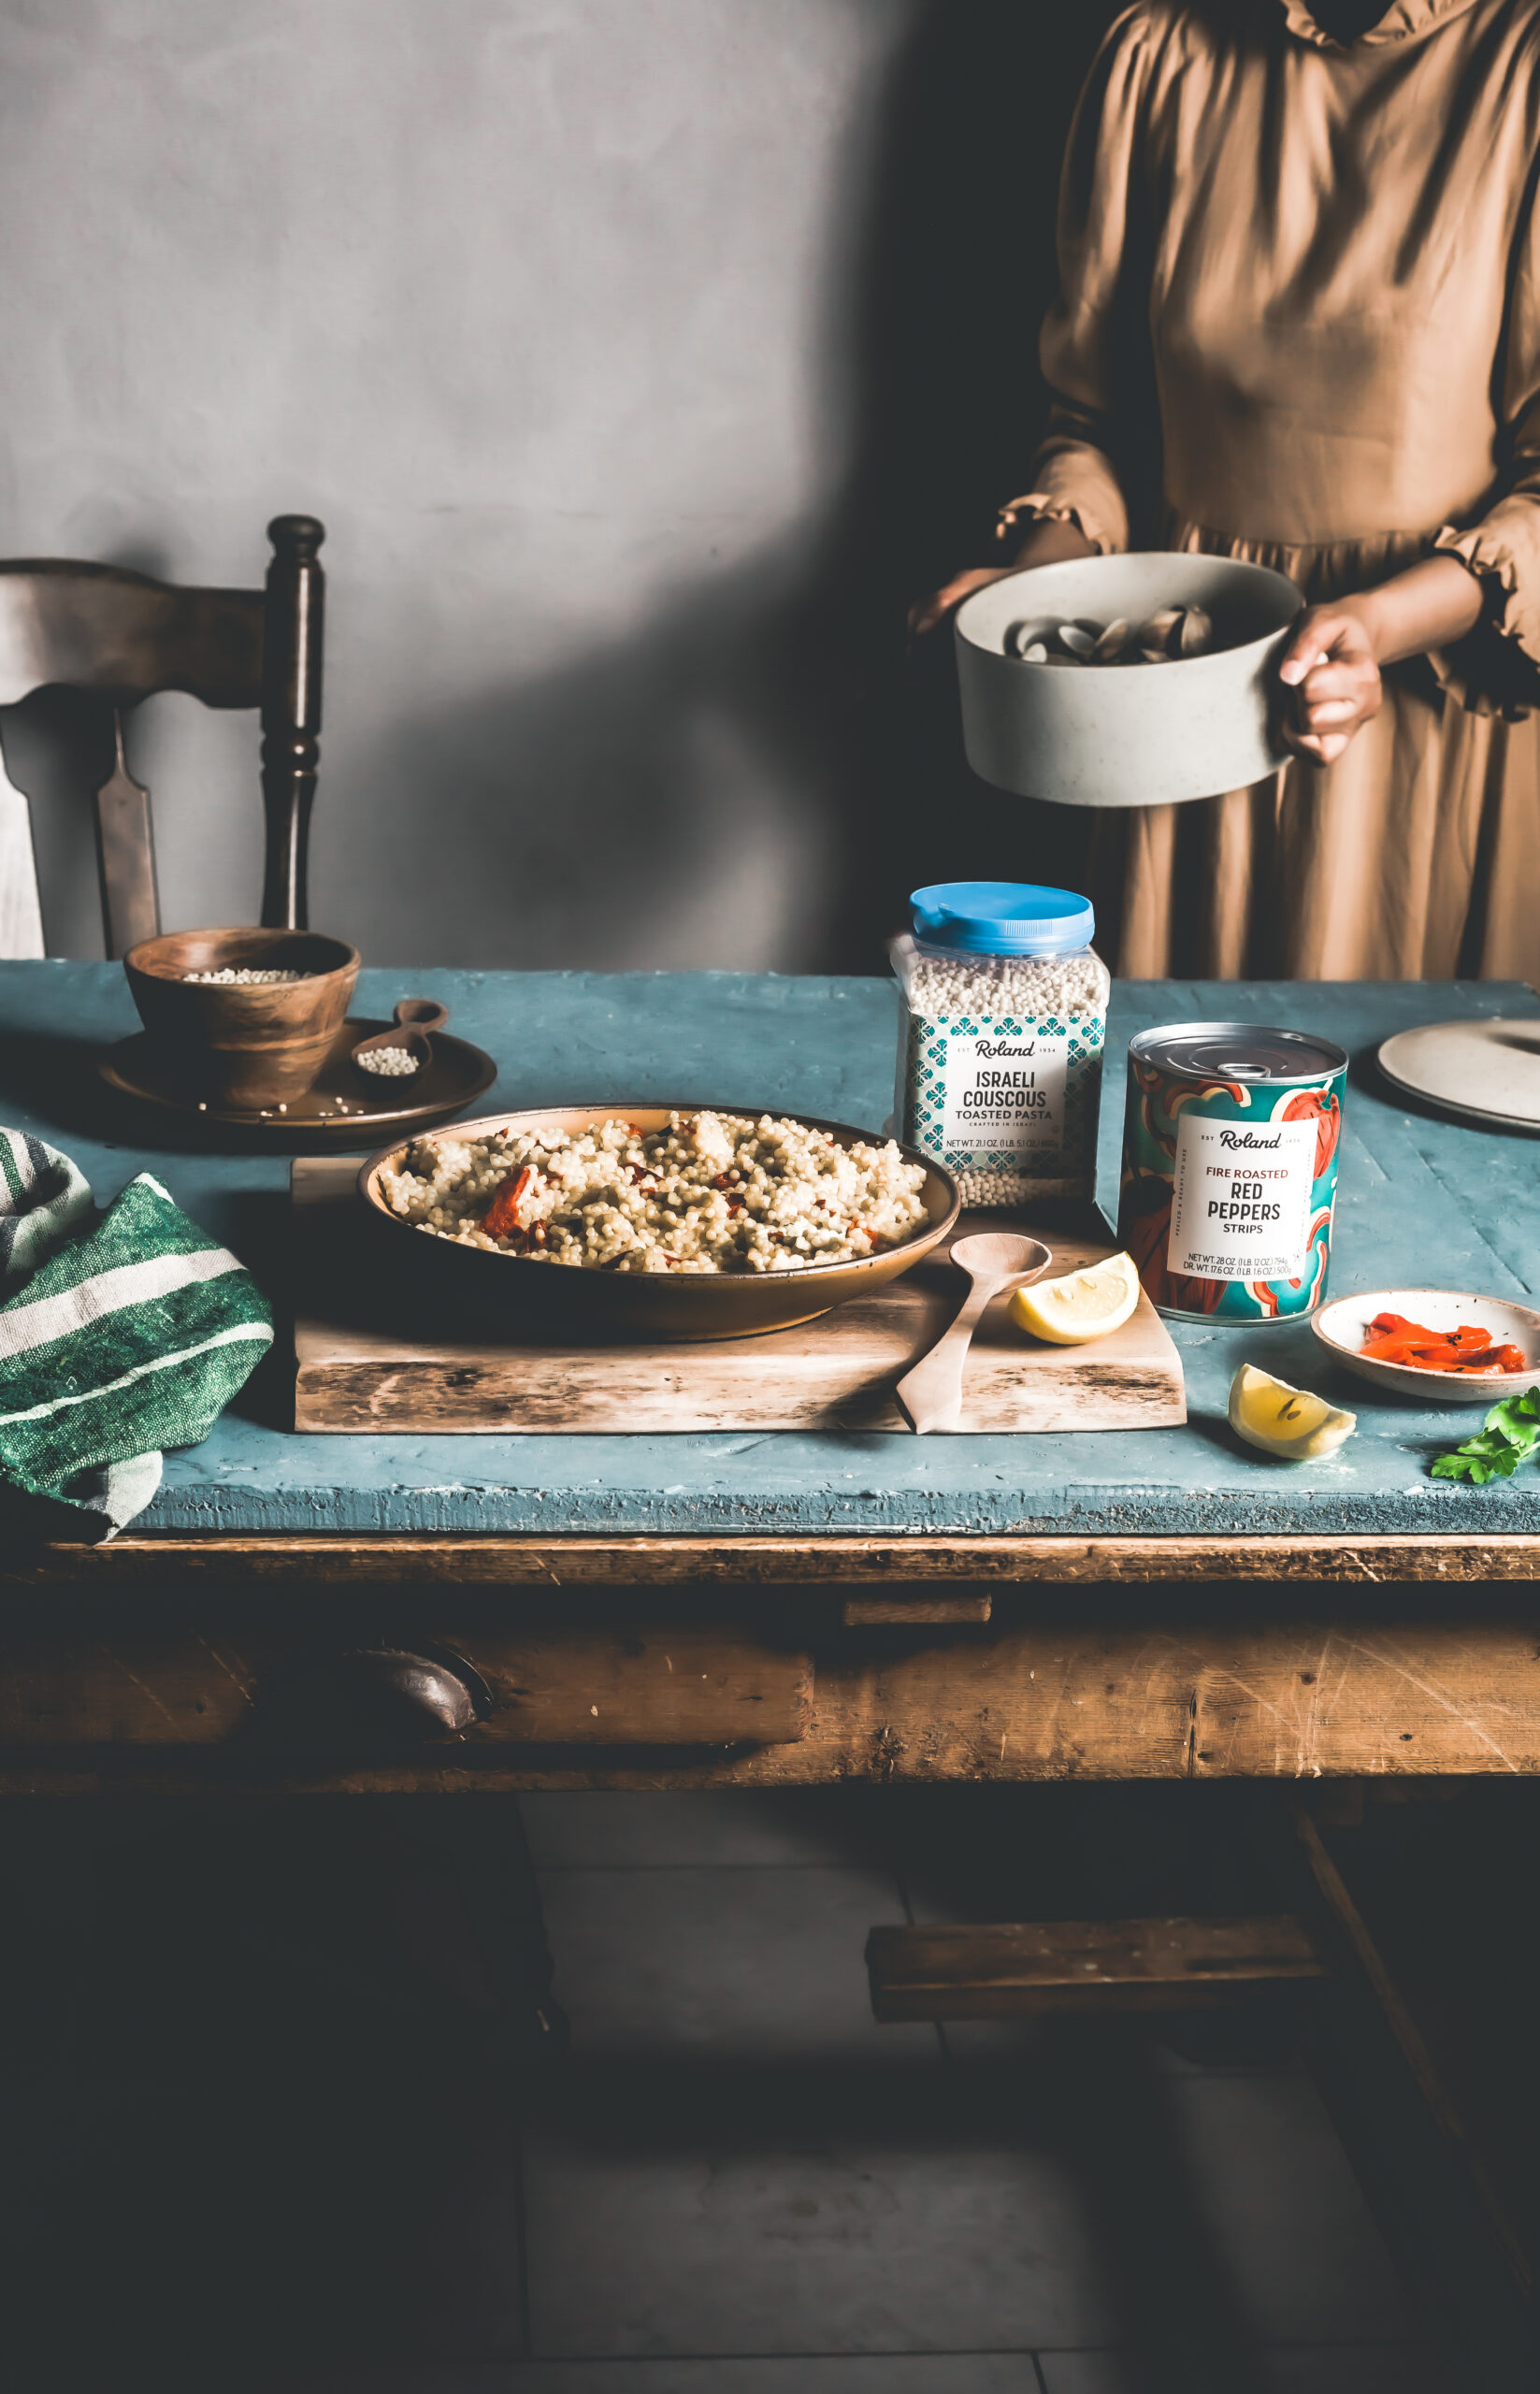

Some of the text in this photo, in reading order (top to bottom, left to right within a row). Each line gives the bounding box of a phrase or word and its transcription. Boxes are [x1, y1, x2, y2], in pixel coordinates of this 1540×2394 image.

[975, 1040, 1035, 1059] Roland
[976, 1072, 1034, 1088] ISRAELI
[963, 1090, 1046, 1107] COUSCOUS
[956, 1111, 1052, 1119] TOASTED PASTA
[1219, 1131, 1281, 1150] Roland
[1206, 1167, 1288, 1179] FIRE ROASTED
[1231, 1182, 1262, 1199] RED
[1208, 1201, 1280, 1220] PEPPERS
[1223, 1223, 1263, 1233] STRIPS
[1188, 1253, 1202, 1262] NET
[1202, 1256, 1215, 1264] WT.
[1184, 1262, 1195, 1270] DR.
[1211, 1265, 1222, 1274] 17.6
[1223, 1266, 1234, 1275] OZ.
